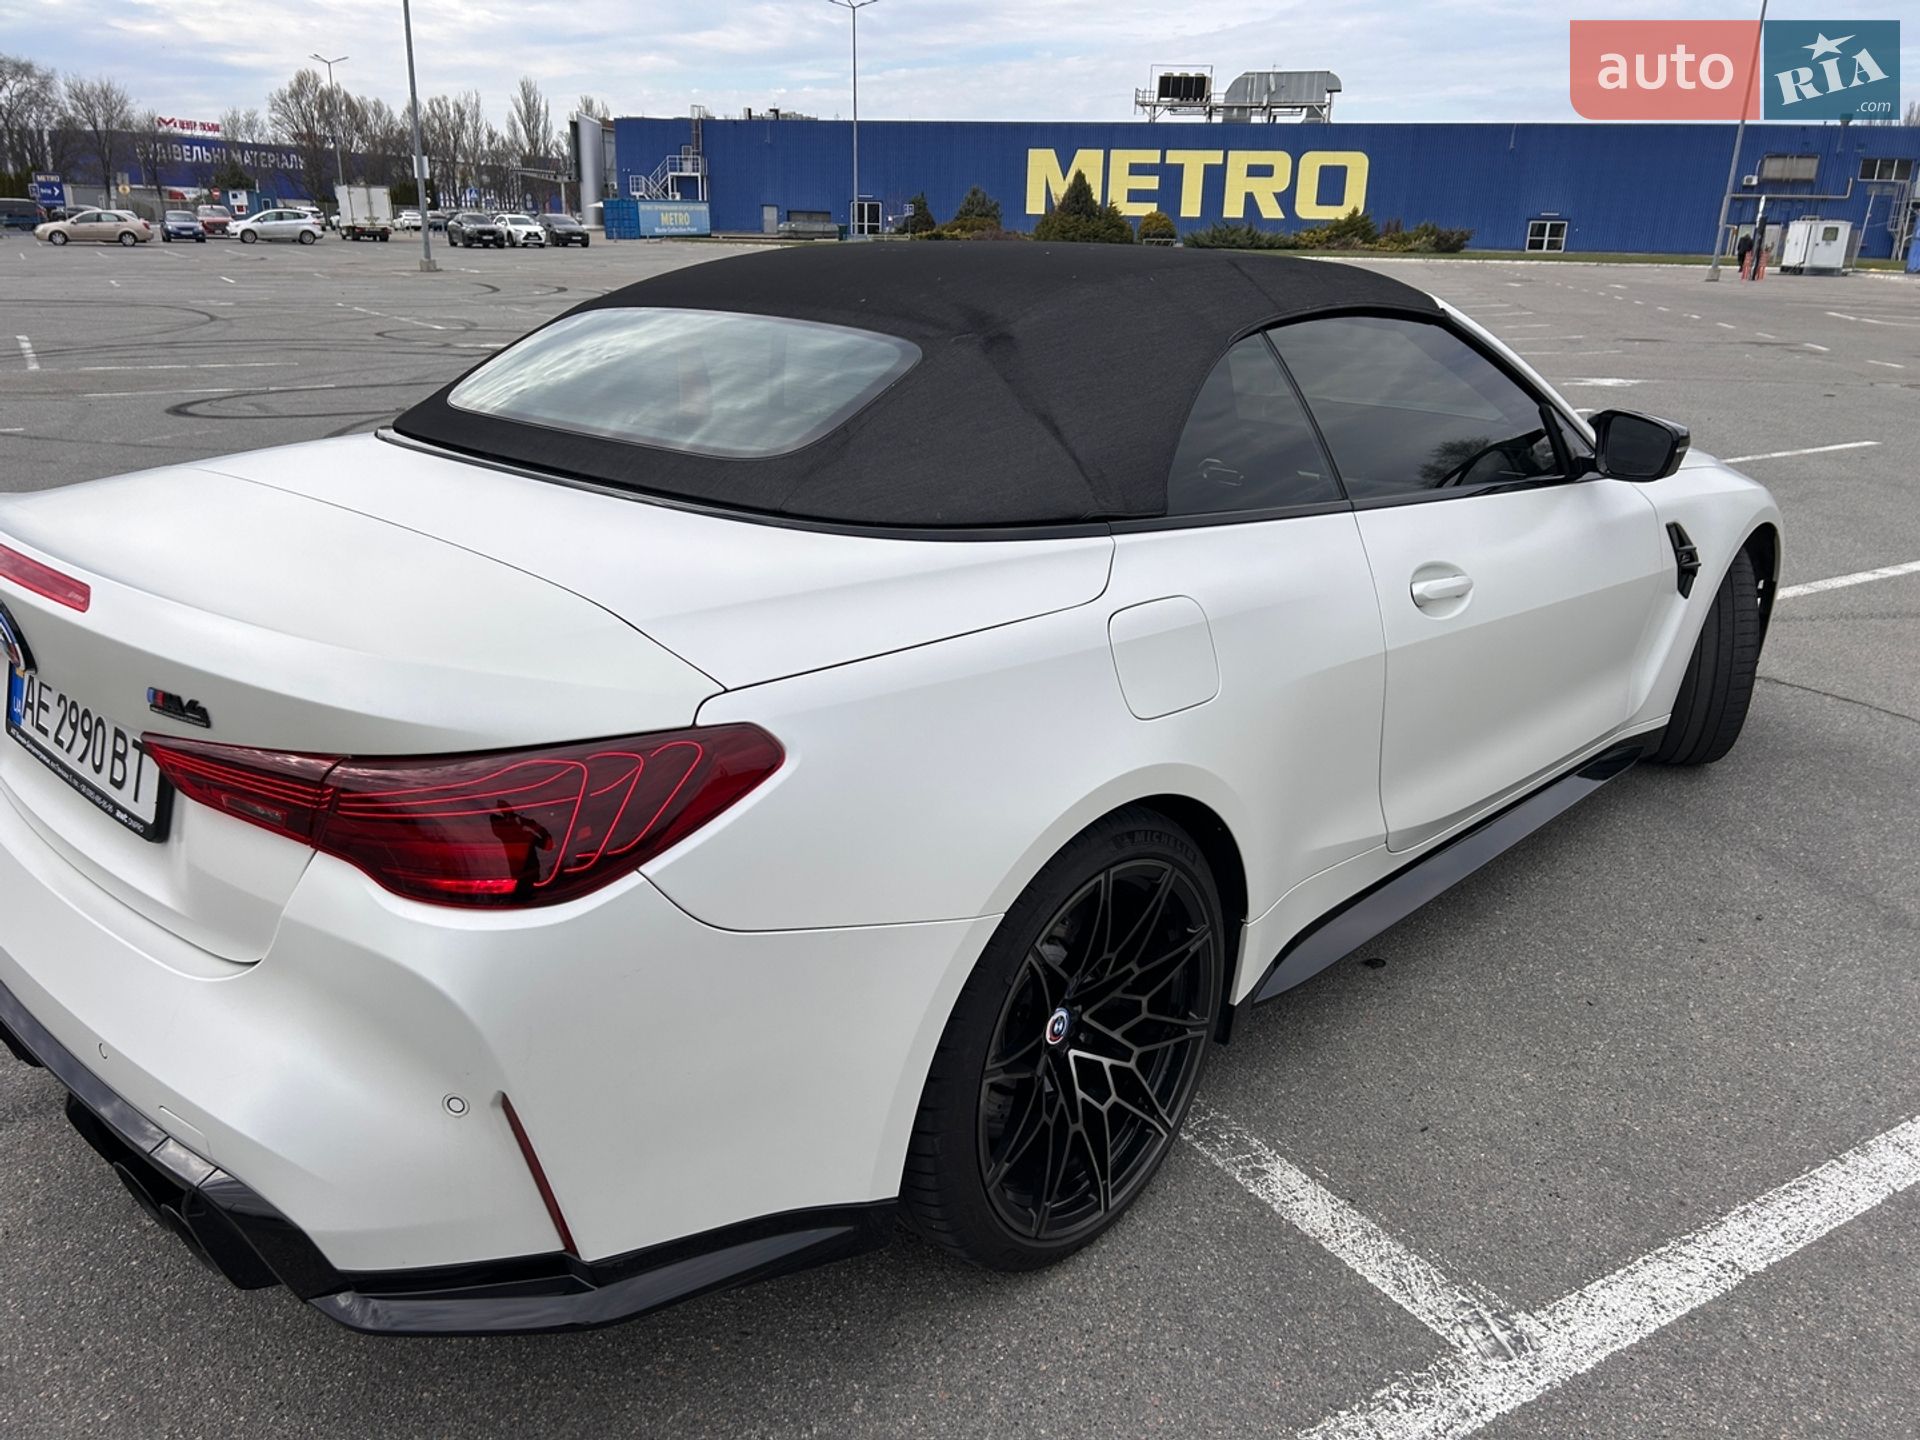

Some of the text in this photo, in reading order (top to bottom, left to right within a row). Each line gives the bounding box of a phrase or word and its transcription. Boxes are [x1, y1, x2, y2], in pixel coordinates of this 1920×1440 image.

[1025, 148, 1370, 220] METRO
[661, 212, 690, 225] METRO
[23, 675, 52, 738] AE
[54, 693, 107, 775] 2990
[109, 726, 145, 803] BT
[1134, 831, 1196, 864] MICHELIN
